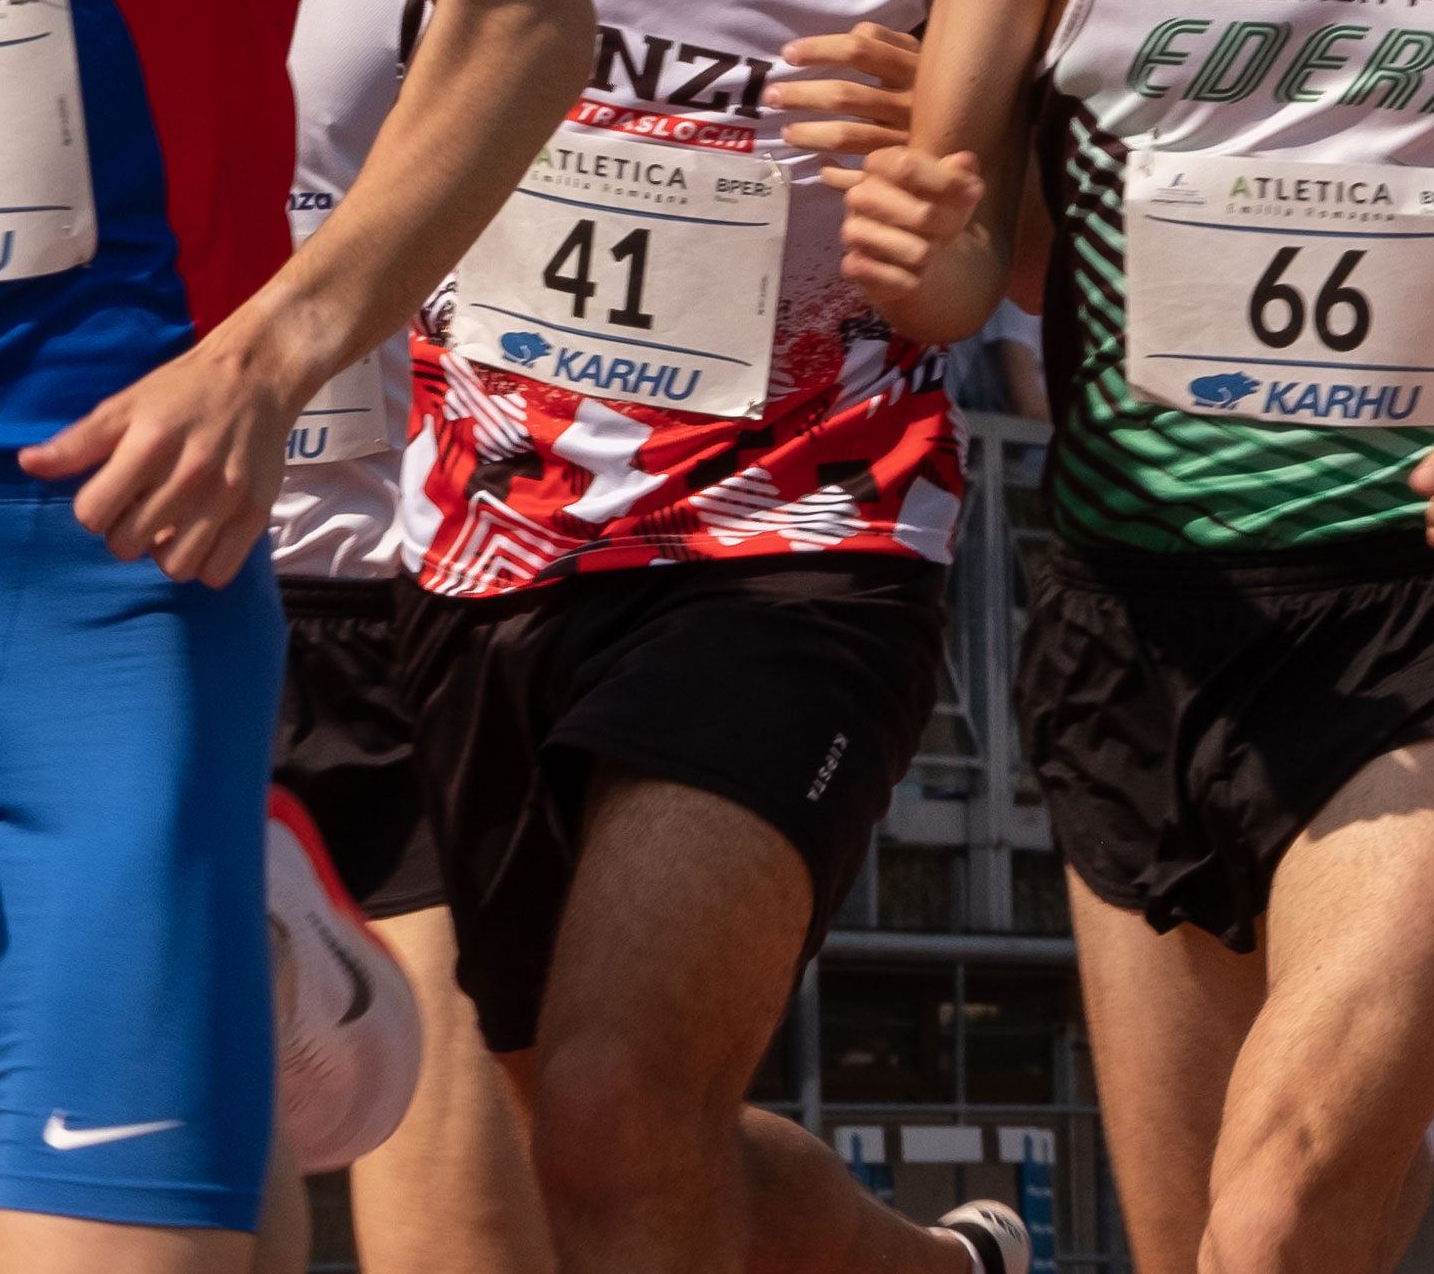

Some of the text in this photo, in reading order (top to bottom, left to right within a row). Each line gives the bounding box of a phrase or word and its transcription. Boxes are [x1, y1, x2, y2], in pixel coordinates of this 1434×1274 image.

[588, 24, 774, 121] NZI
[576, 100, 753, 150] TRASLOCHI
[536, 146, 688, 191] ATLETICA
[1229, 175, 1394, 206] ATLETICA
[542, 219, 654, 330] 41
[1248, 245, 1372, 353] 66
[553, 346, 703, 401] KARHU
[1262, 381, 1423, 421] KARHU
[806, 731, 849, 802] KIPSTA
